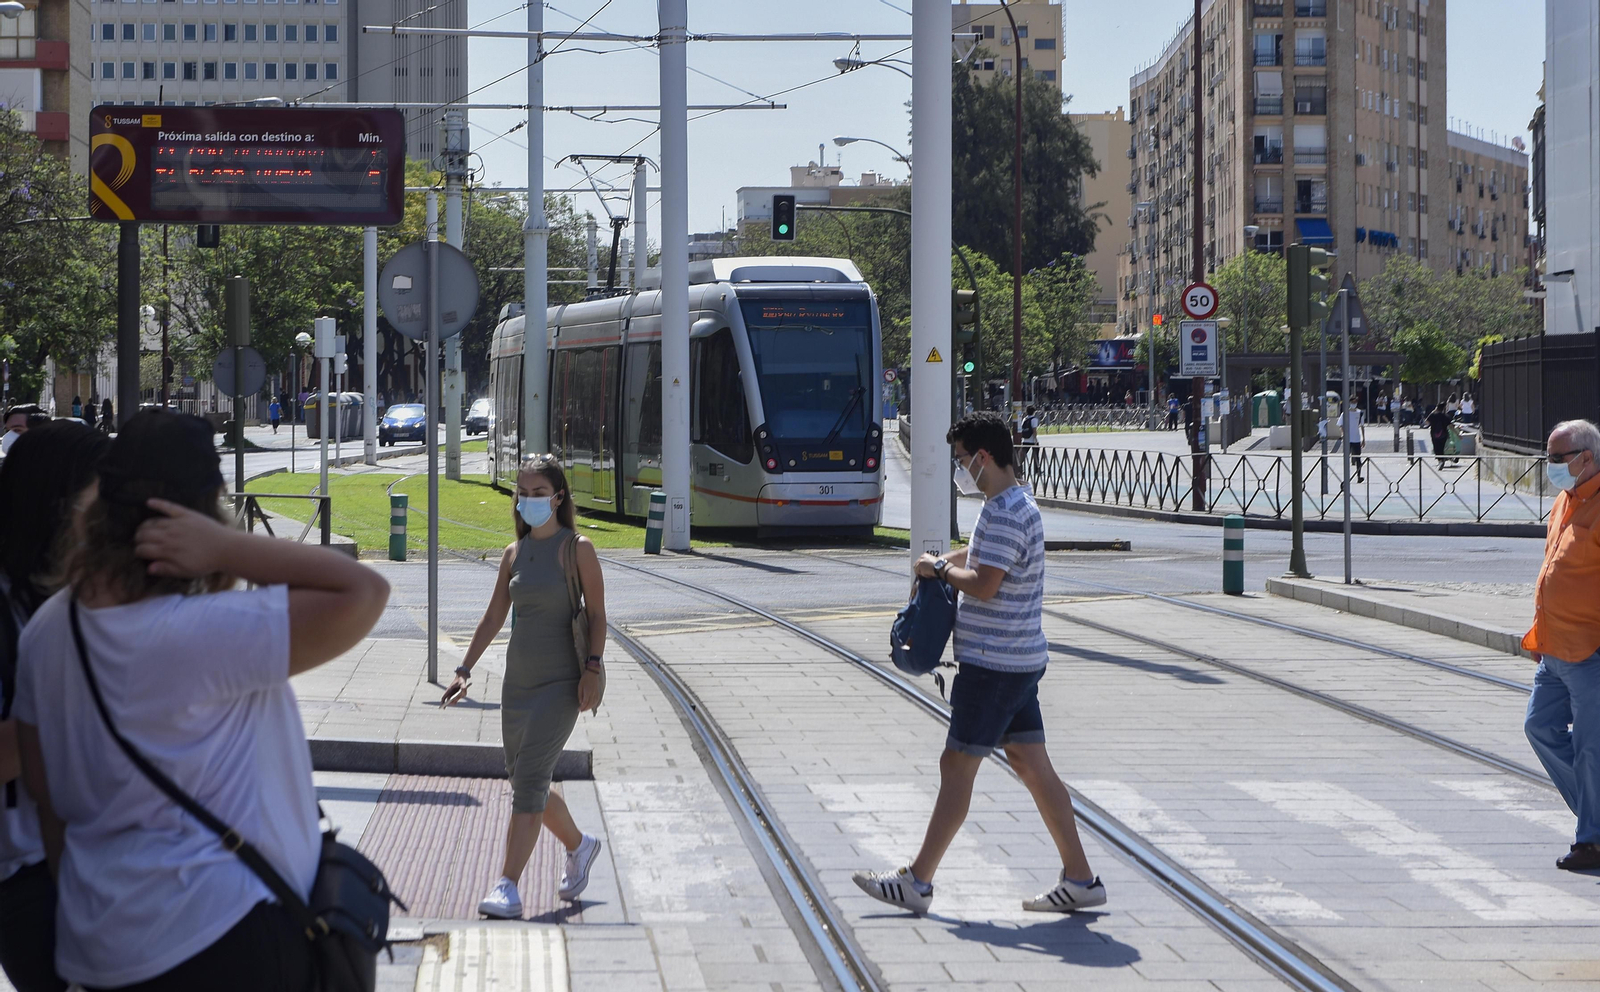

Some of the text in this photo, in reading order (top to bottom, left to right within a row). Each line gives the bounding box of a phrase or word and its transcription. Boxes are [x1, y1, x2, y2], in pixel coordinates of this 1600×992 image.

[158, 131, 315, 142] Próxima salida con destino a:
[358, 133, 383, 143] Min.
[1190, 295, 1210, 307] 50
[819, 485, 834, 495] 301
